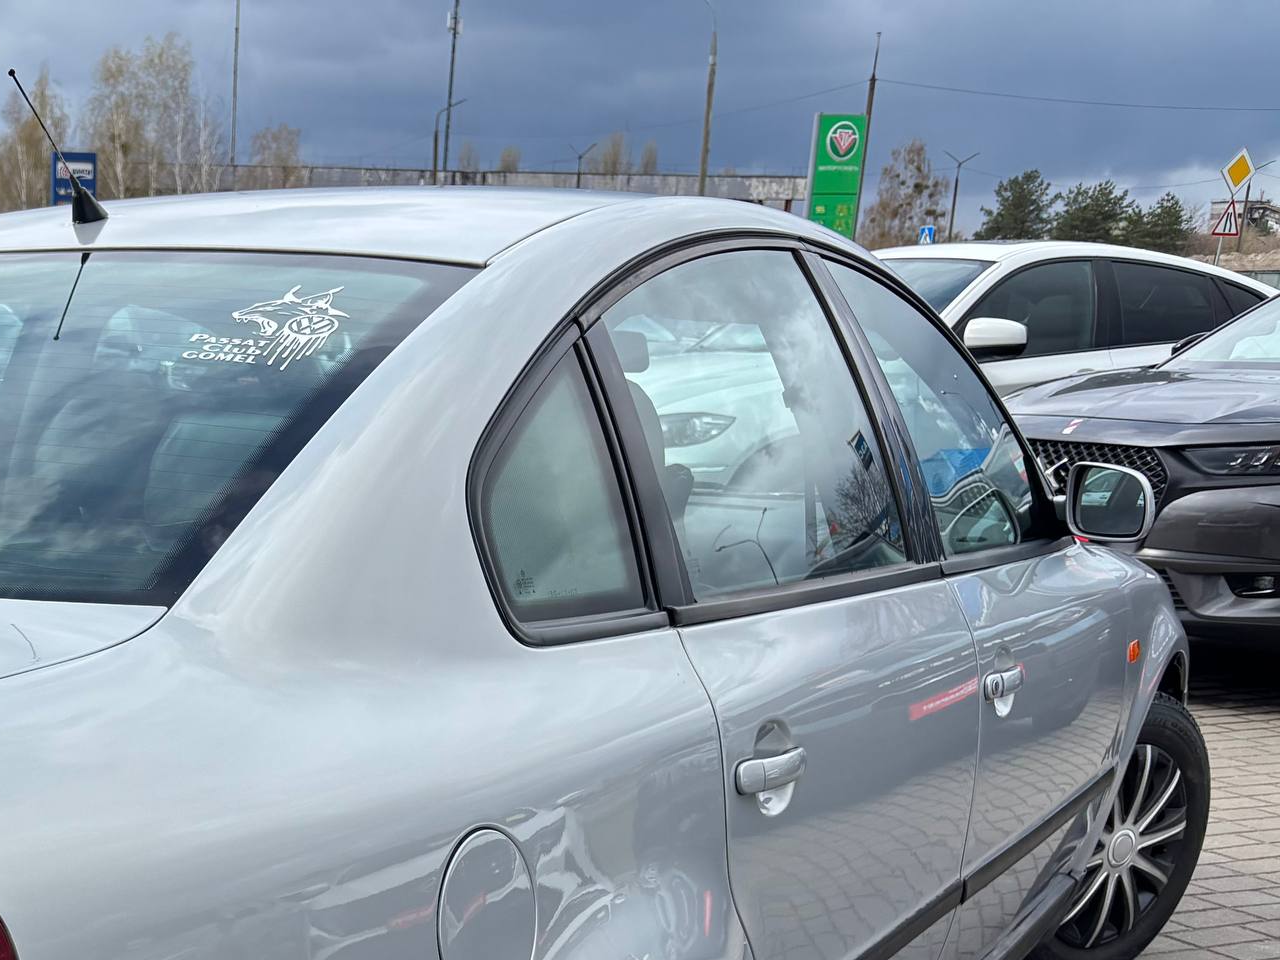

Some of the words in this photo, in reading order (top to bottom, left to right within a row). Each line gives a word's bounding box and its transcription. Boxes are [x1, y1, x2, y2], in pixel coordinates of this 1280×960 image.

[189, 333, 271, 347] PASSAT
[202, 343, 262, 355] Club
[181, 350, 256, 364] GOMEL
